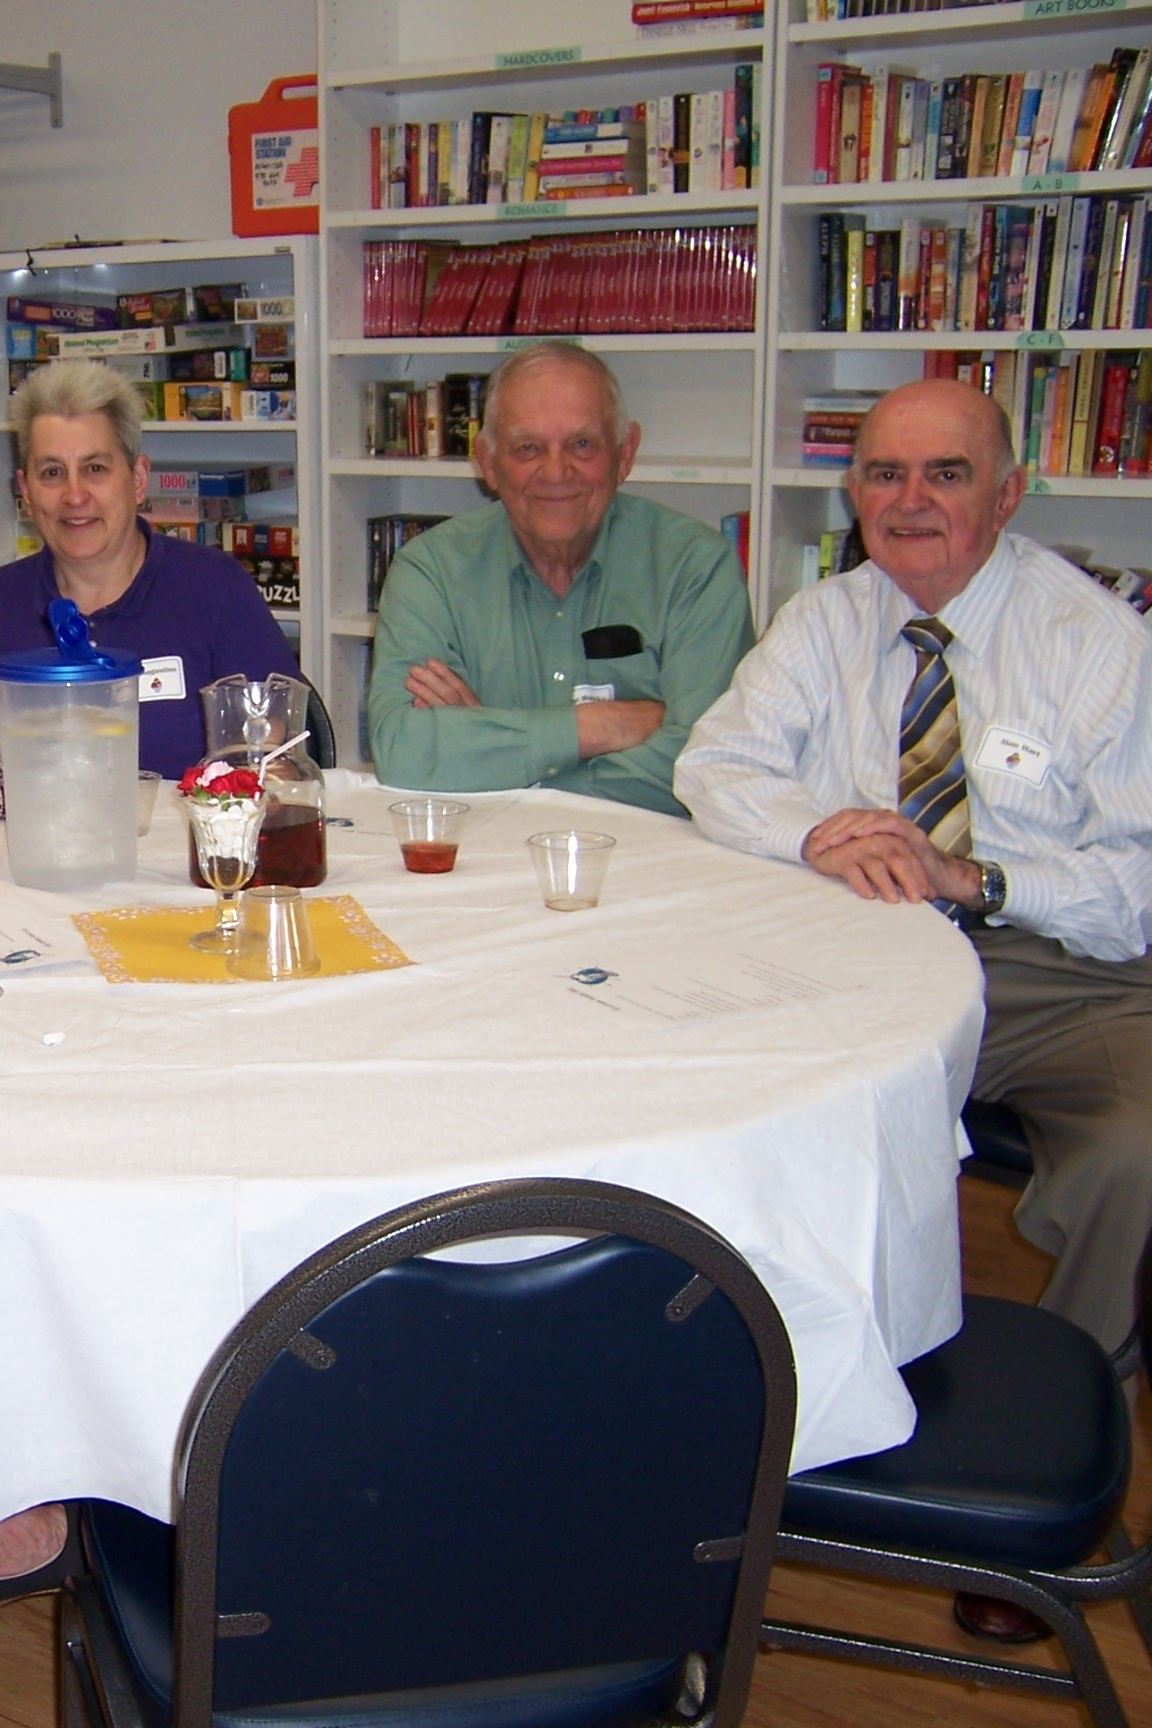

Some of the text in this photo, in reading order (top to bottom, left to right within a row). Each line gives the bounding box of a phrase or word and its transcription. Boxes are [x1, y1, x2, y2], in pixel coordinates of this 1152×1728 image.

[503, 49, 574, 67] HARDCOVERS
[254, 136, 292, 148] FIRST AID
[255, 149, 286, 160] STATION
[504, 203, 558, 216] ROMANCE
[51, 307, 76, 320] 1000
[260, 301, 282, 316] 1000
[159, 474, 185, 489] 1000
